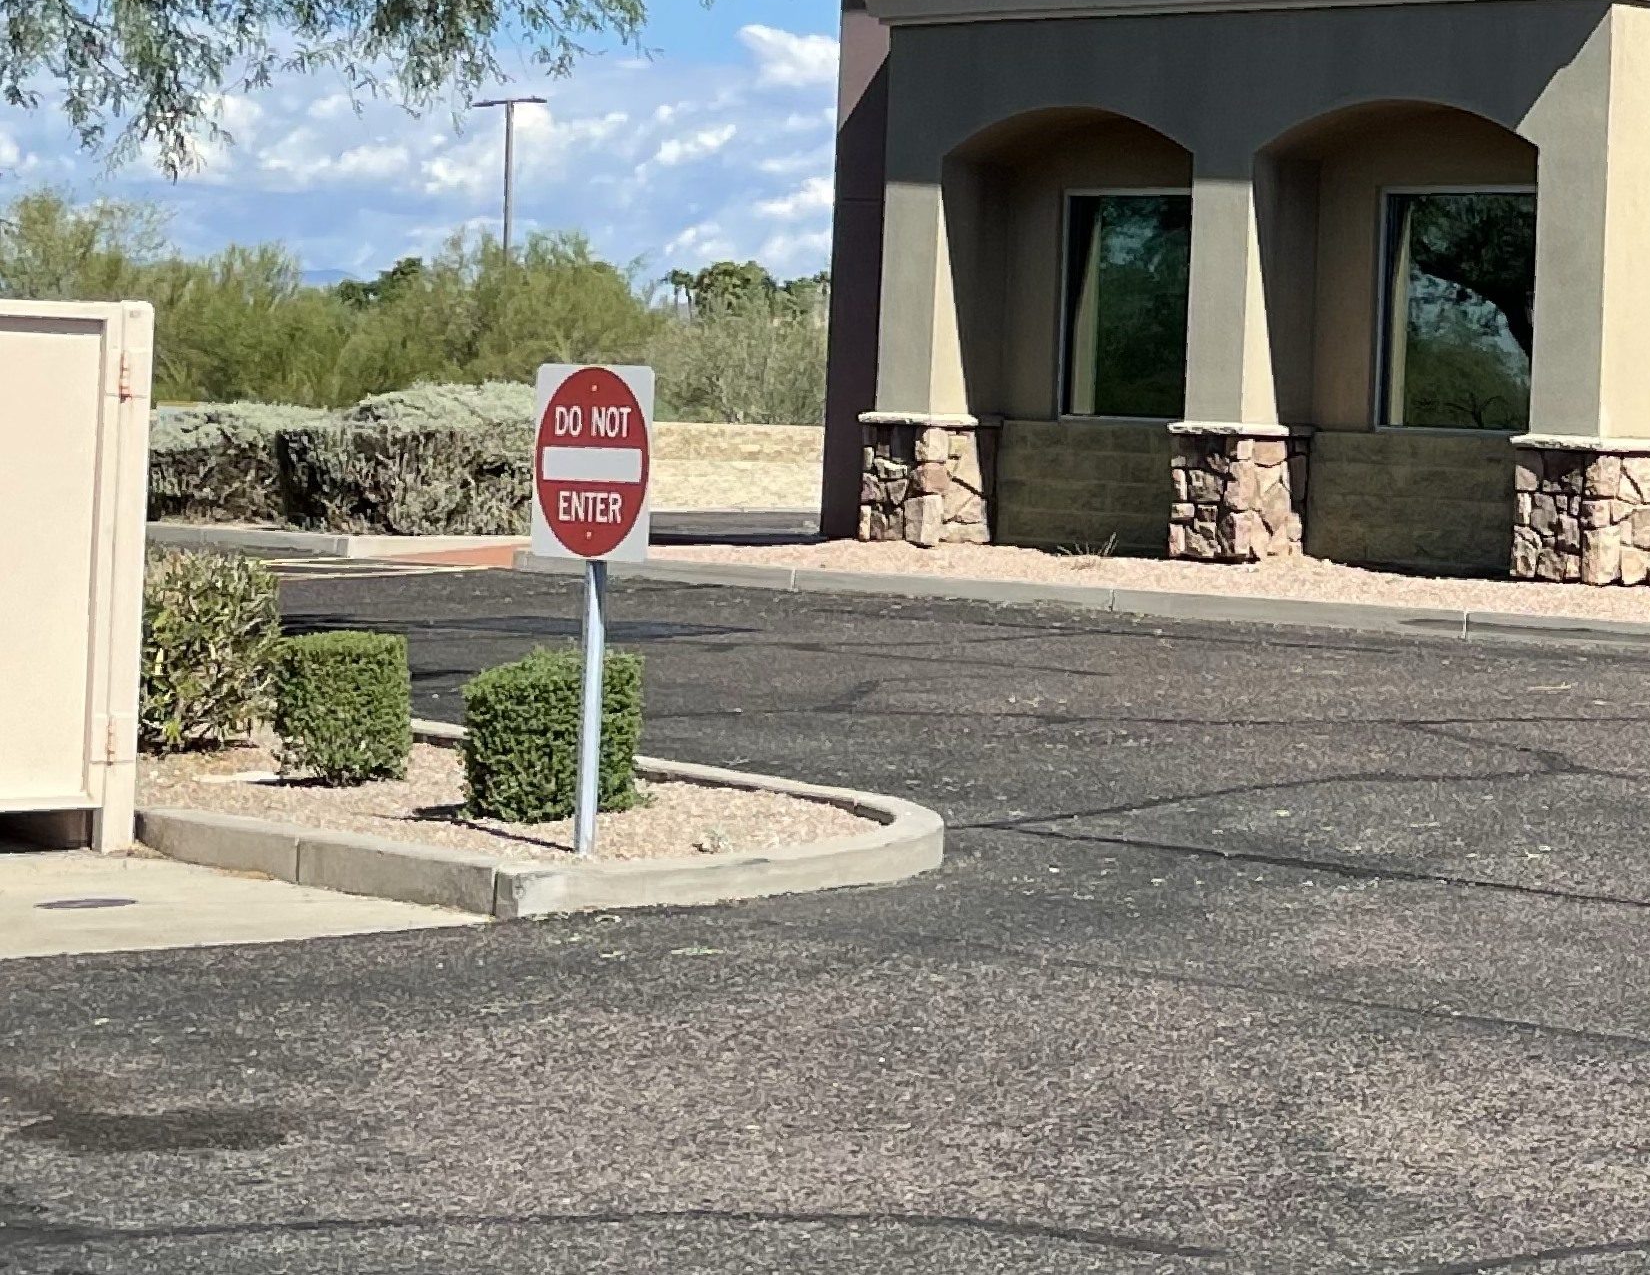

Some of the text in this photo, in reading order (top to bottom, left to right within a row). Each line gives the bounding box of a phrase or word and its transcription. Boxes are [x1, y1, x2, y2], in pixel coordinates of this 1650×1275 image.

[555, 405, 631, 438] DO NOT
[558, 491, 622, 523] ENTER
